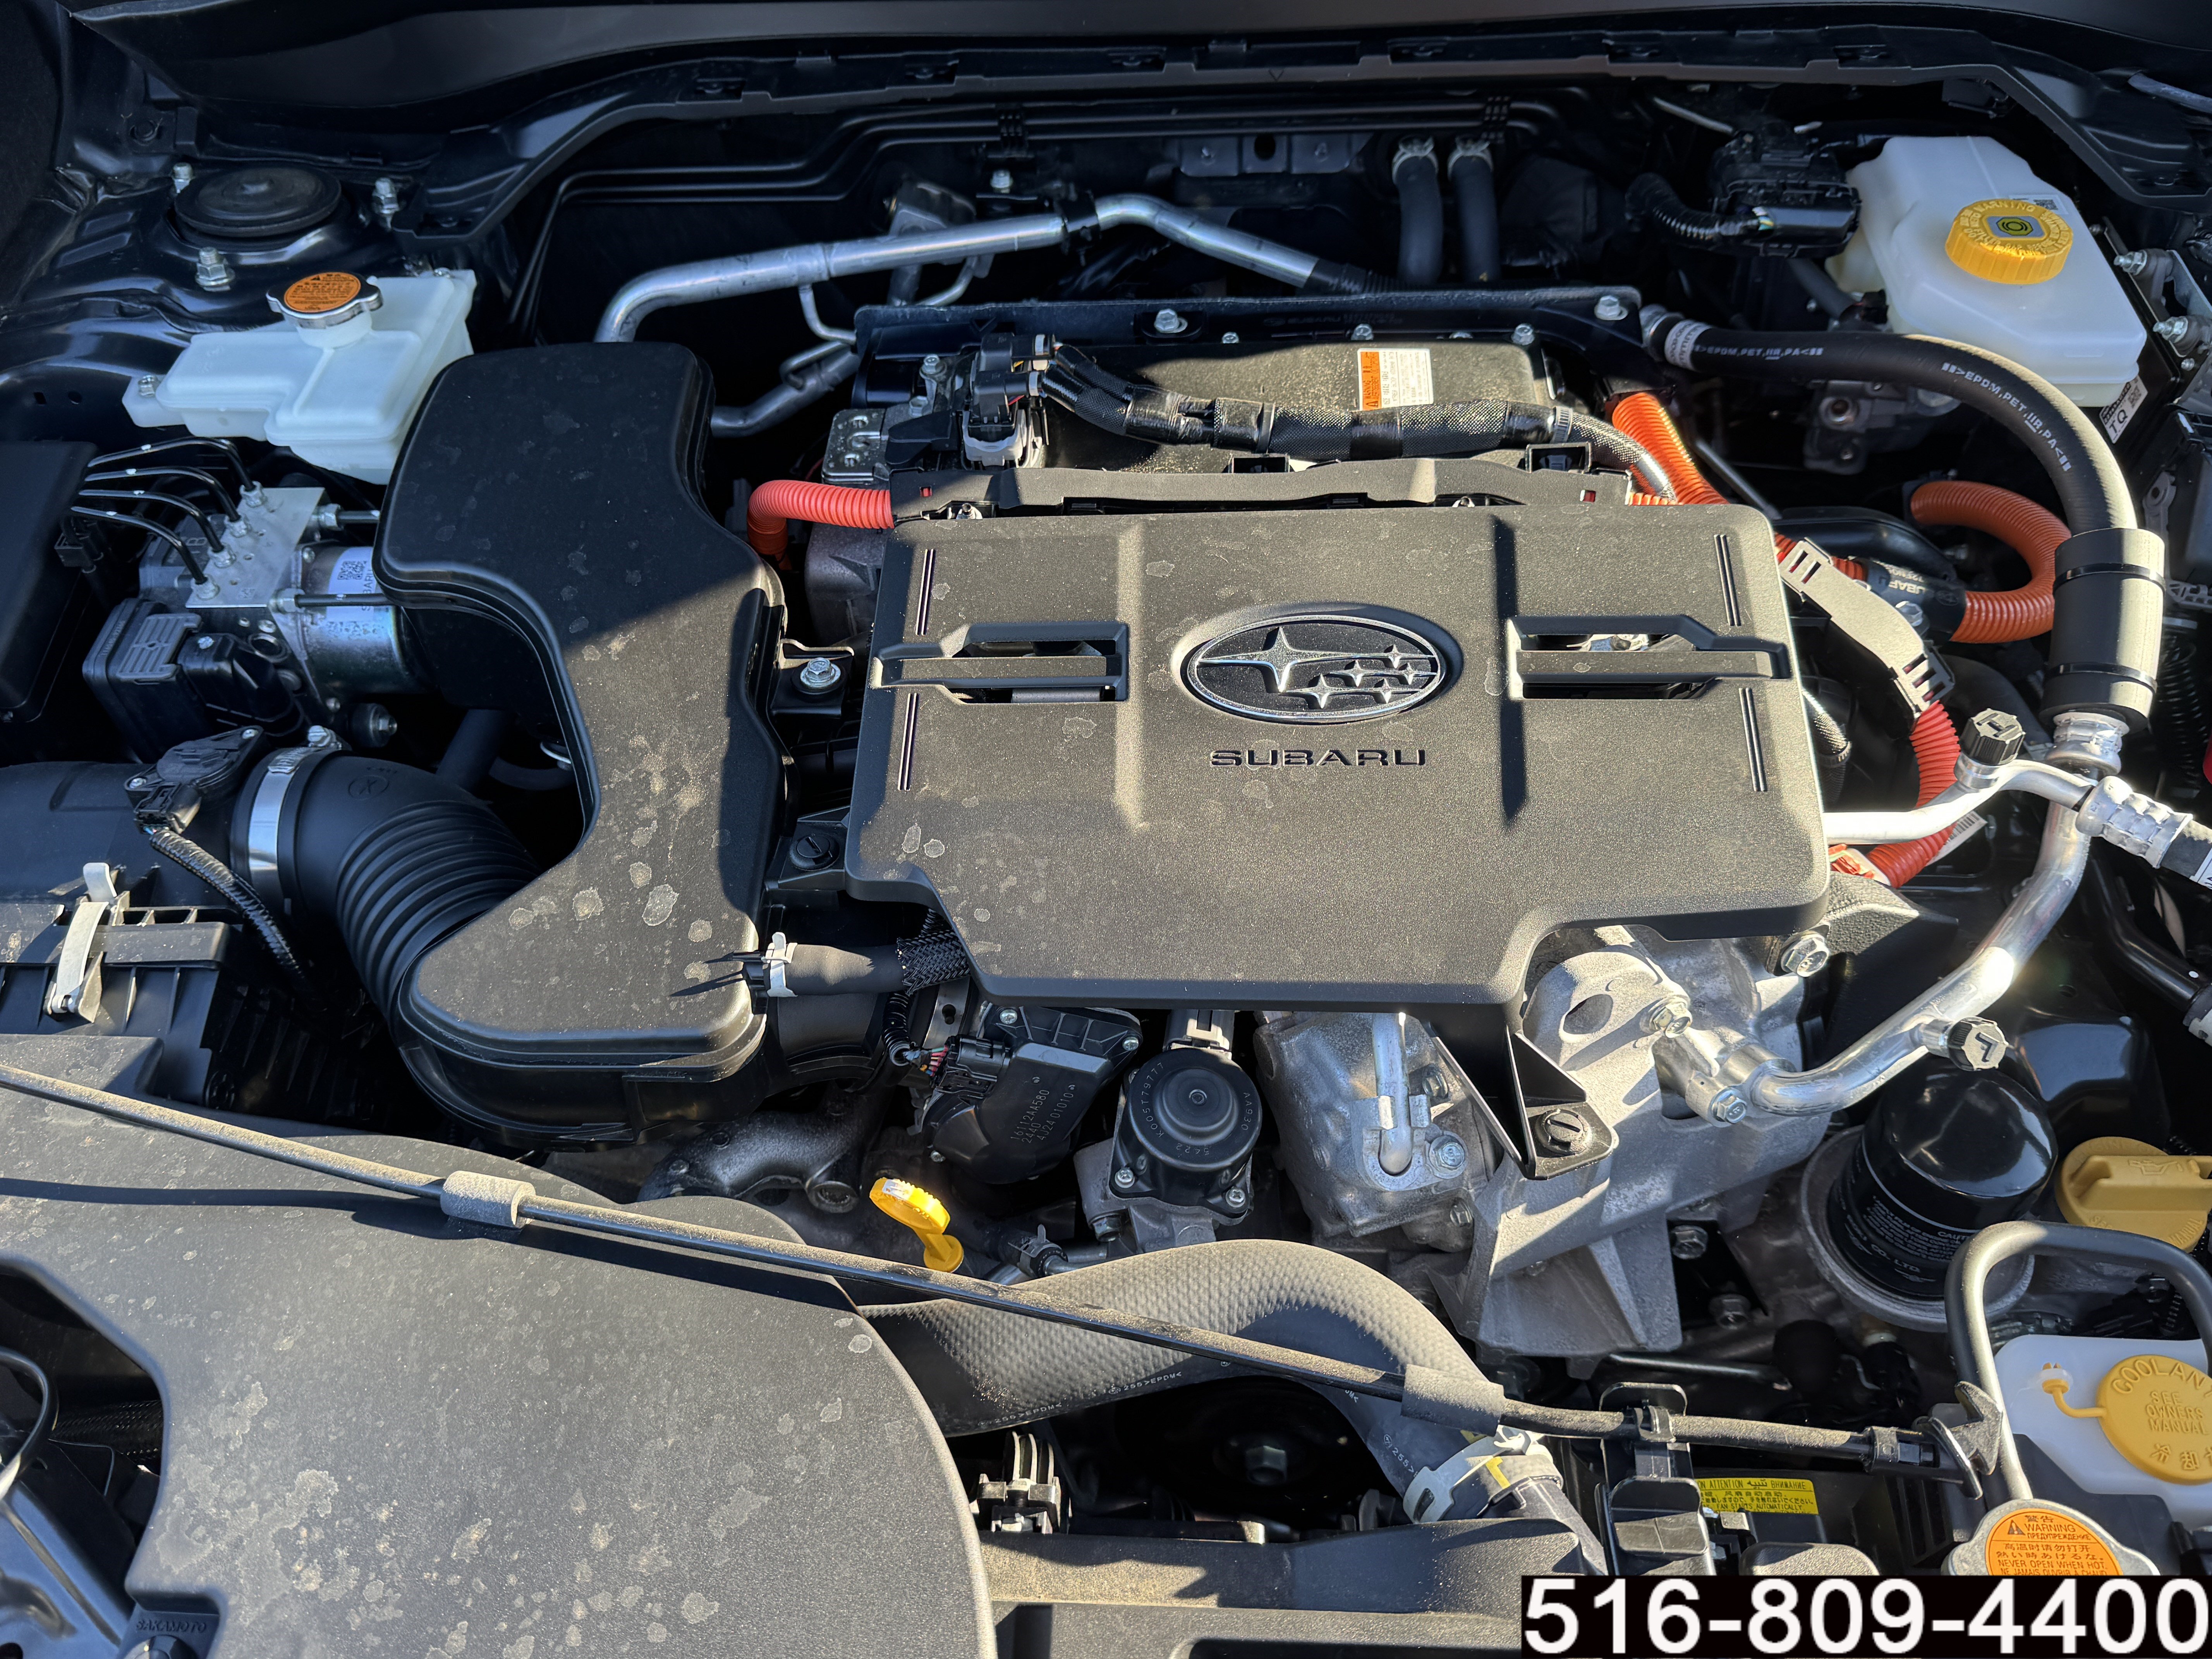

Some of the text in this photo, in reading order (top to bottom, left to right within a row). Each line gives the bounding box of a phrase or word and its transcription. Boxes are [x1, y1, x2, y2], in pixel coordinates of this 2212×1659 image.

[1209, 749, 1426, 766] SUBARU
[1010, 1089, 1049, 1140] 16112AA580
[1021, 1123, 1041, 1143] 2440
[2150, 1391, 2183, 1405] SEE
[2146, 1404, 2203, 1419] OWNERS
[2148, 1418, 2209, 1435] MANUAL
[1709, 1479, 1744, 1489] ATTENTION
[1771, 1480, 1807, 1489] ВНИМАНИЕ
[2024, 1523, 2076, 1533] WARNING
[1998, 1559, 2027, 1568] NEVER
[2030, 1560, 2053, 1569] OPEN
[2056, 1561, 2084, 1569] WHEN
[136, 1619, 206, 1633] SAKAMOTO
